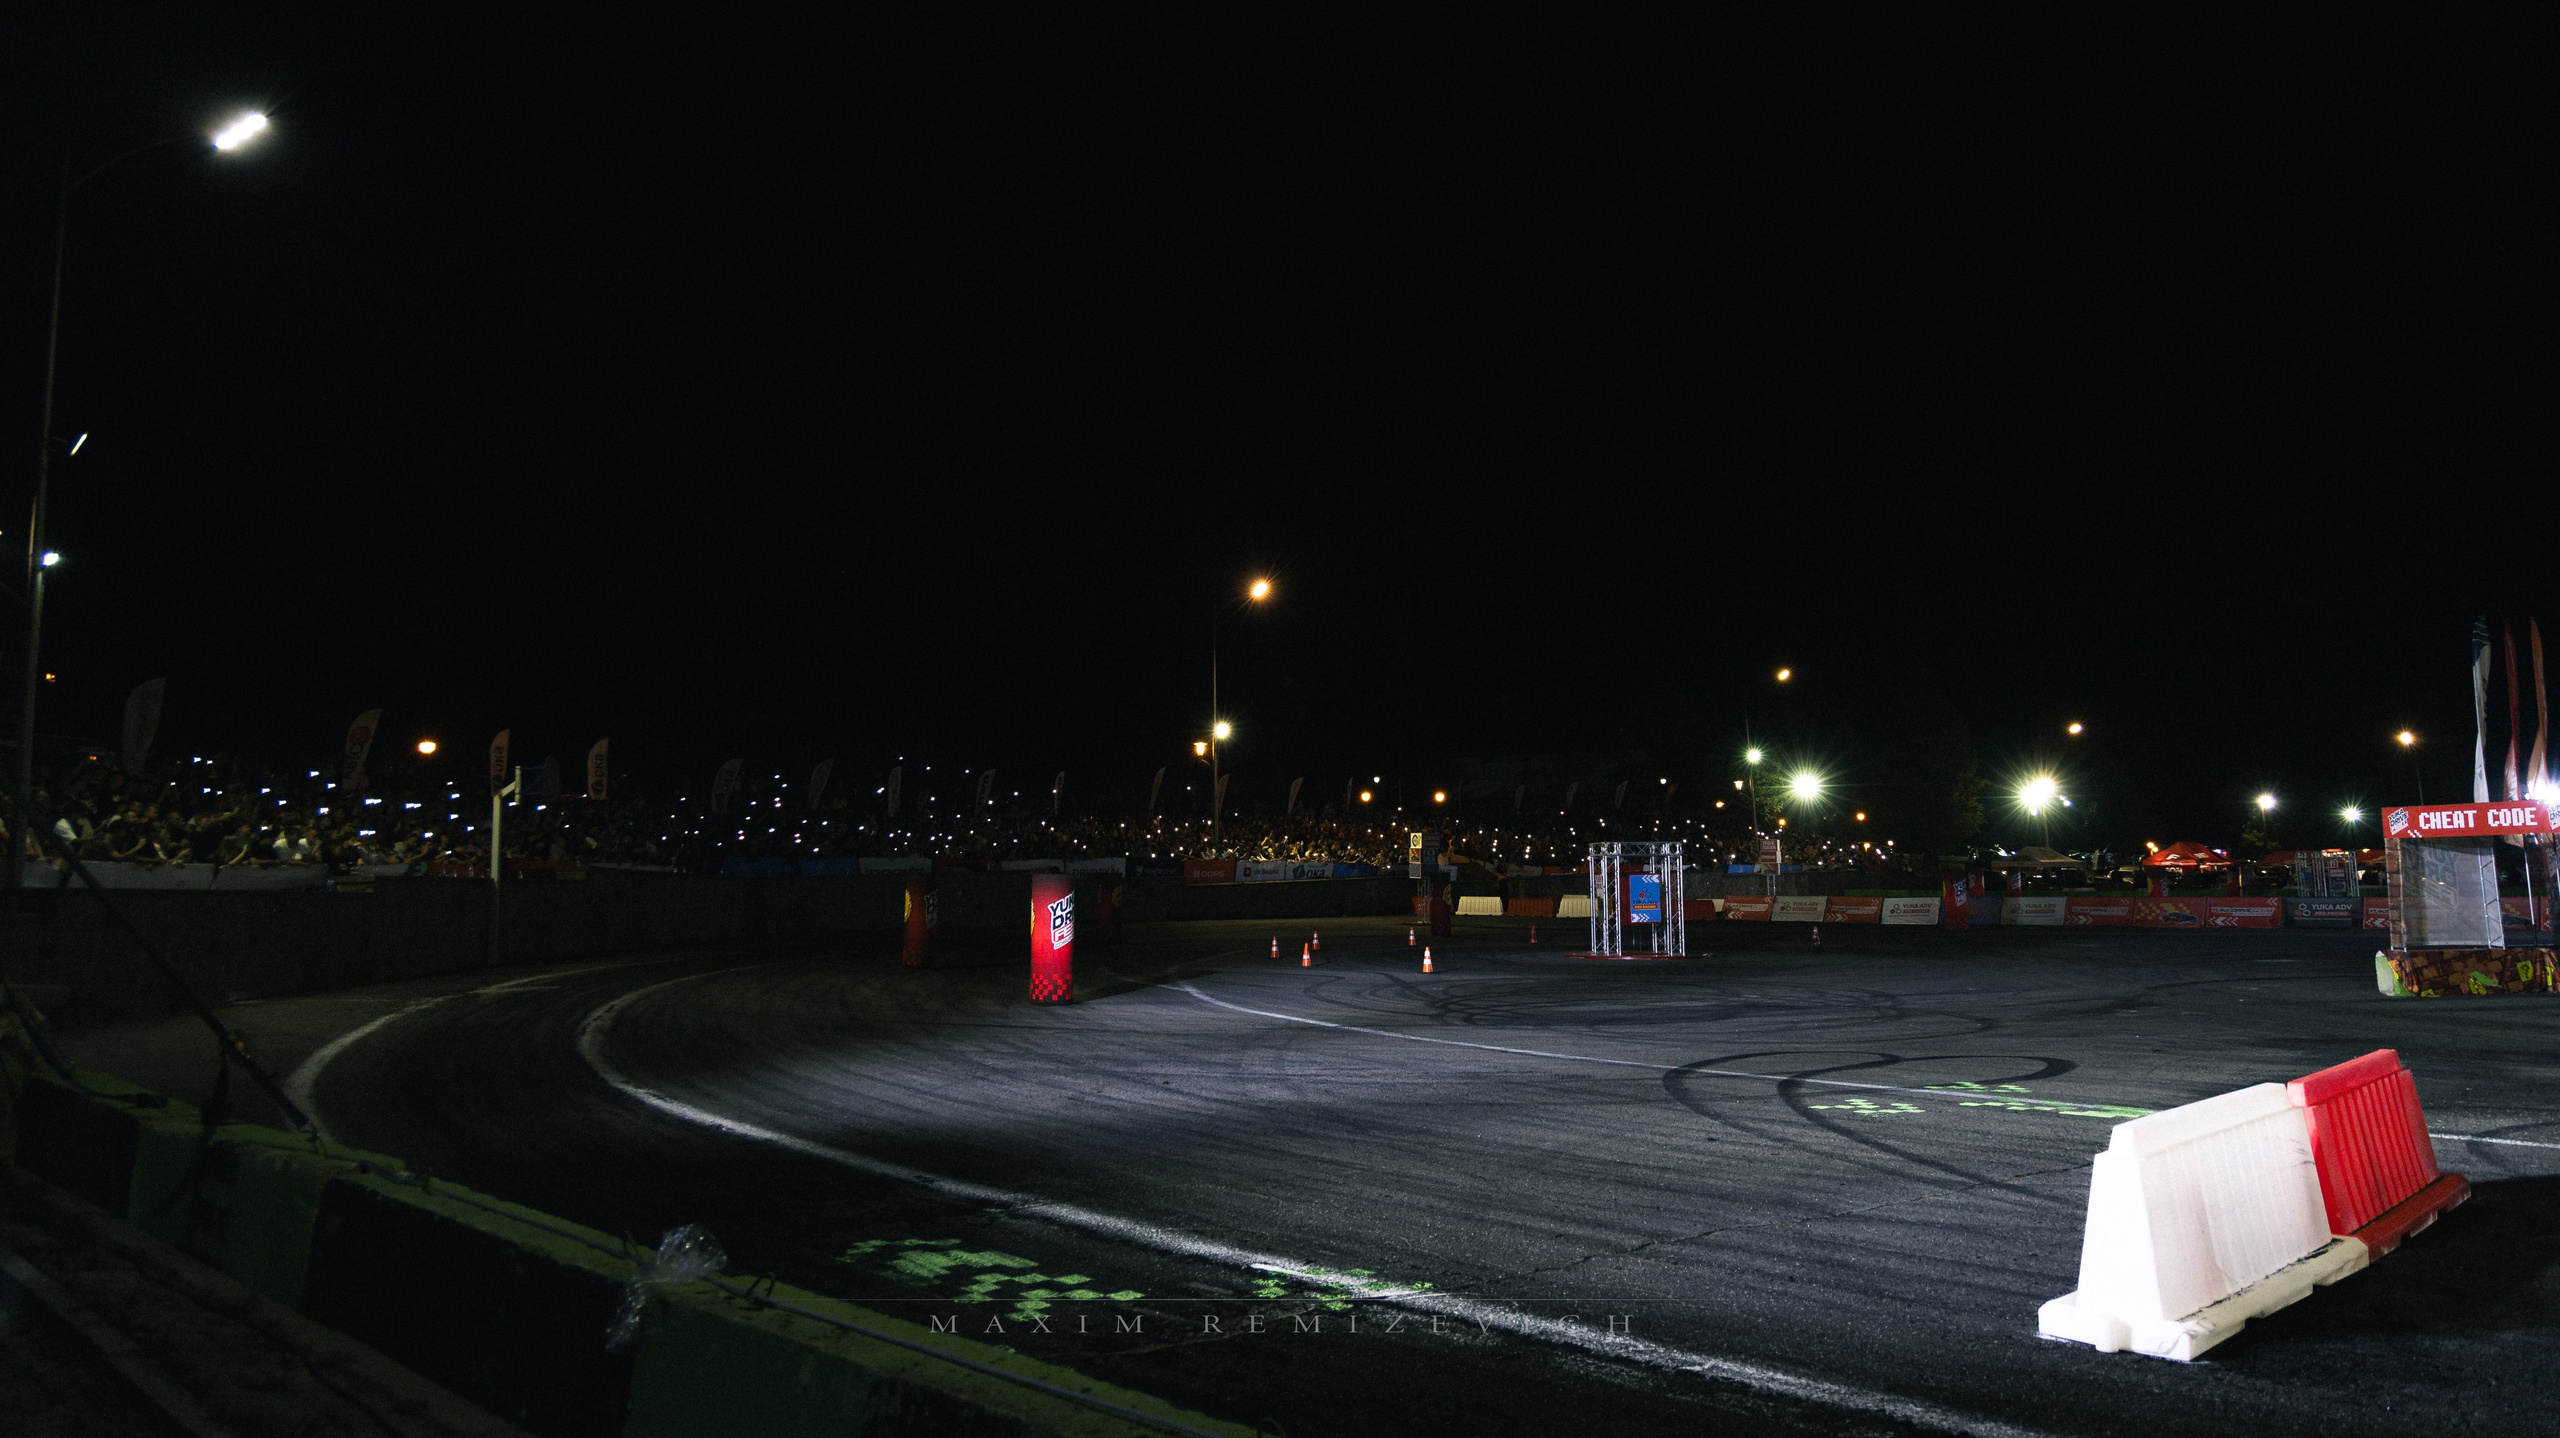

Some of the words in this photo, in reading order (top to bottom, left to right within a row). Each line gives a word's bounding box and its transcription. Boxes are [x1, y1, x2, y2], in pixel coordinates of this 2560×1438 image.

[2419, 810, 2477, 830] CHEAT
[2487, 807, 2538, 828] CODE
[1200, 870, 1225, 878] CORE
